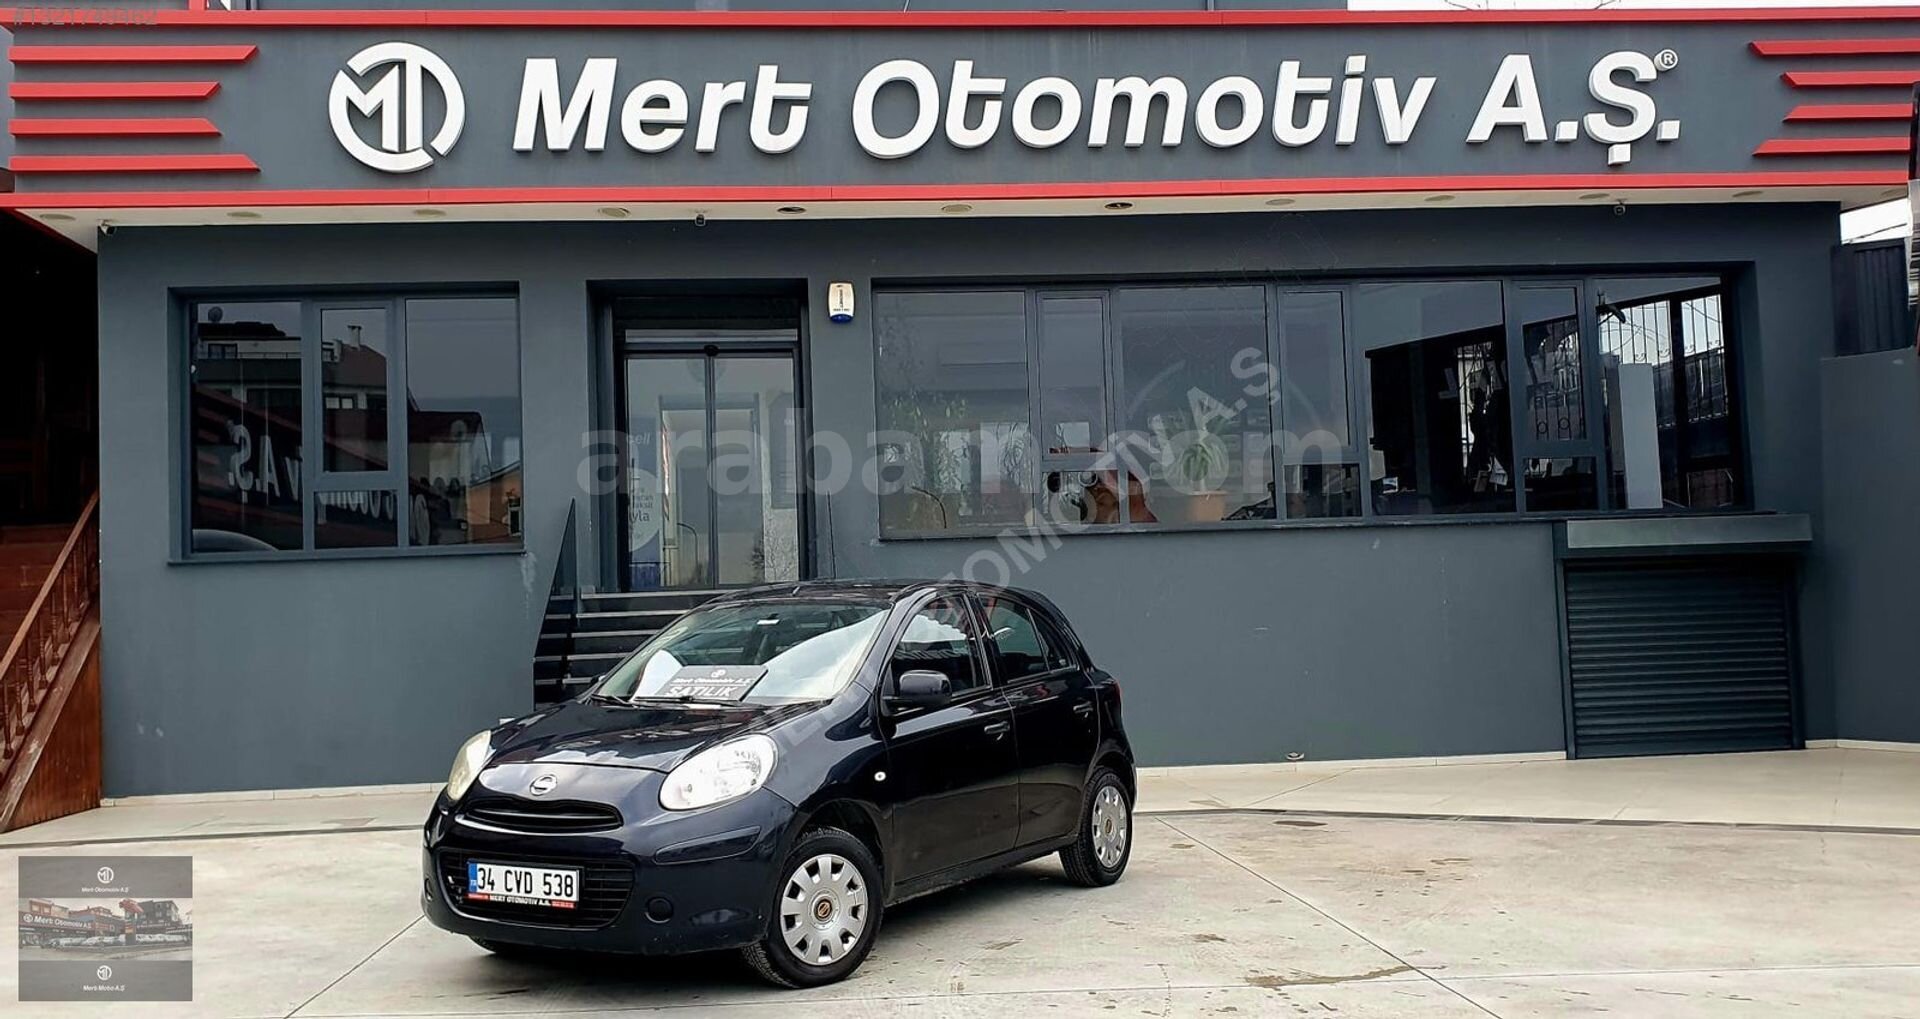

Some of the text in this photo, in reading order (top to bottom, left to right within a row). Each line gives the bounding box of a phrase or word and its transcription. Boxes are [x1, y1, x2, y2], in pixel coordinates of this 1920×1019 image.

[512, 57, 813, 155] Mert
[851, 54, 1437, 160] Otomotiv
[477, 867, 574, 898] 34 CVD 538
